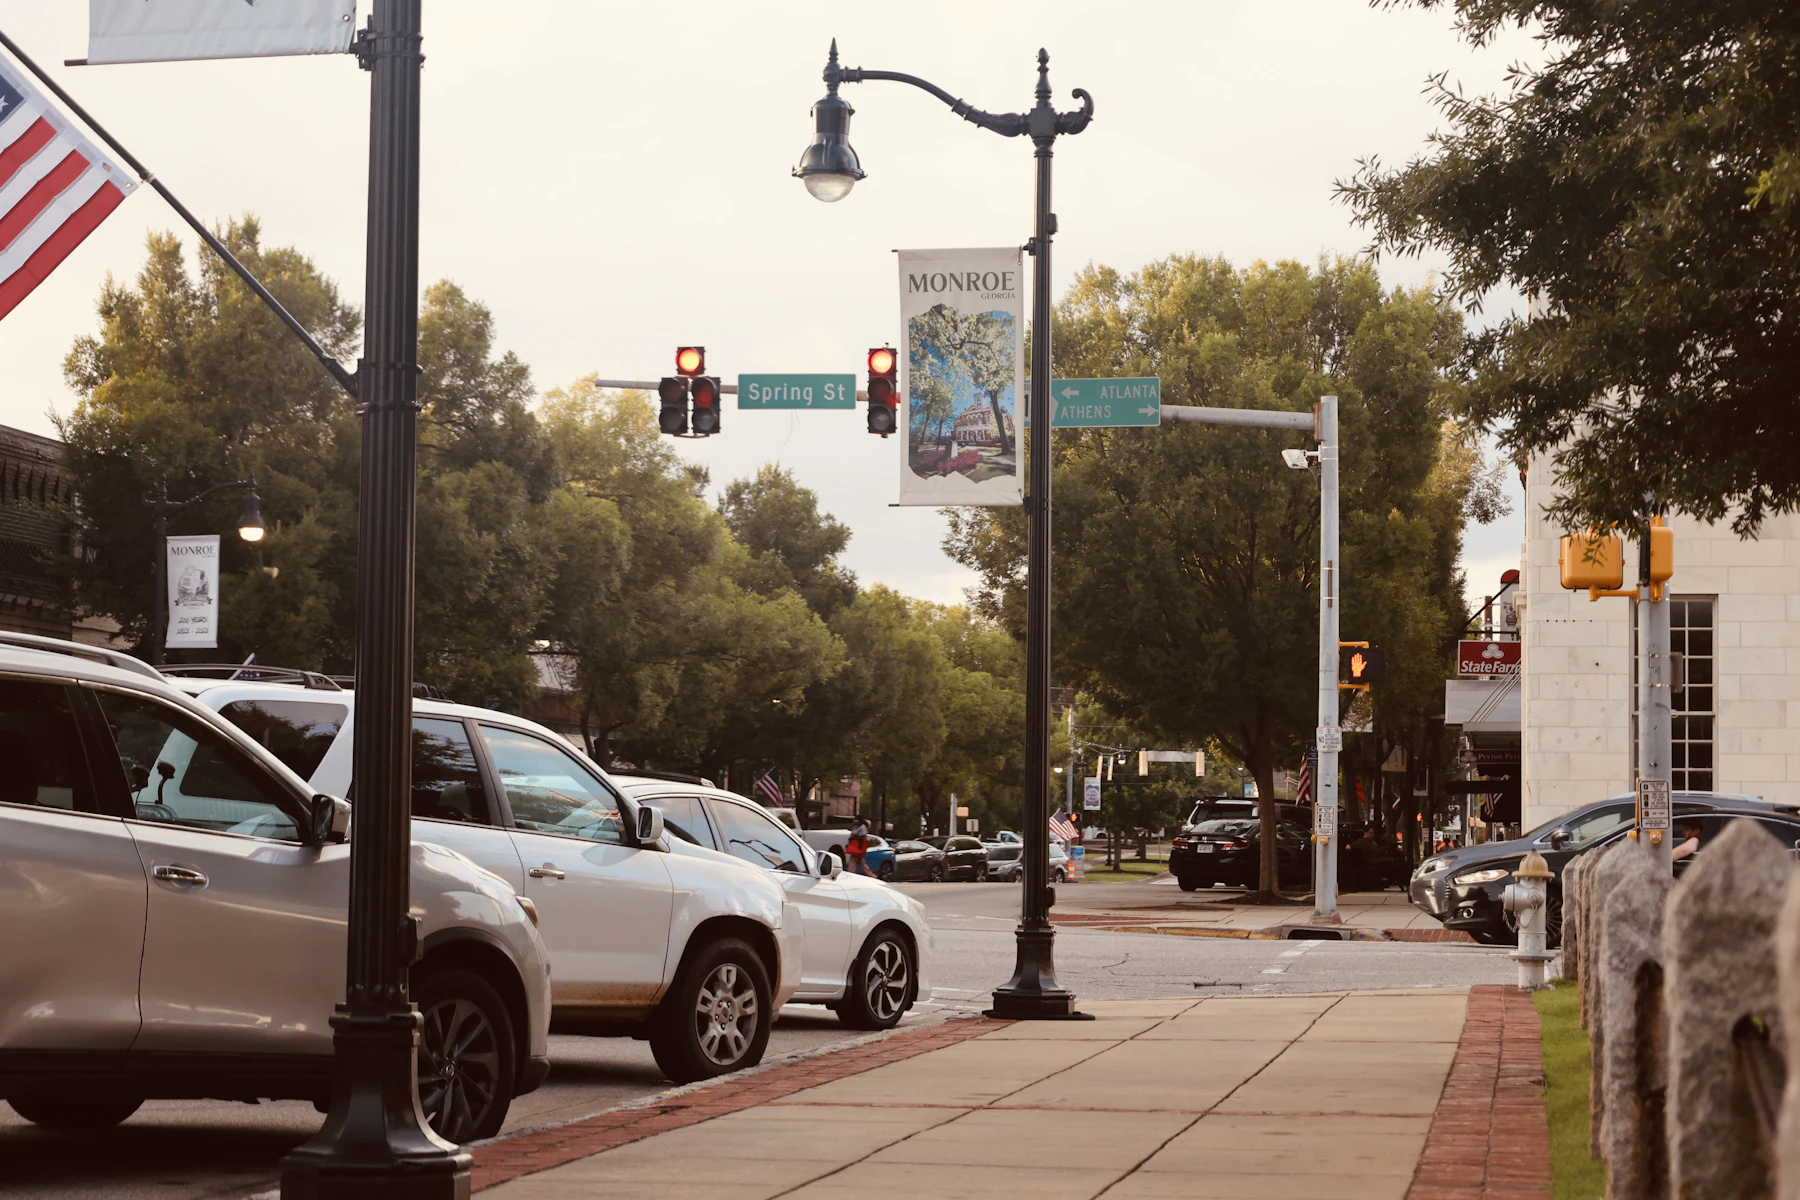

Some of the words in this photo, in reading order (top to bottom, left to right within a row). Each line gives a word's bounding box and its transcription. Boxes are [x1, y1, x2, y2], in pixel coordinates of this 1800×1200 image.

[908, 271, 1015, 293] MONROE
[748, 382, 813, 406] Spring
[823, 383, 846, 400] St
[1100, 384, 1158, 399] ATLANTA
[1060, 404, 1112, 419] ATHENS
[171, 546, 216, 555] MONROE
